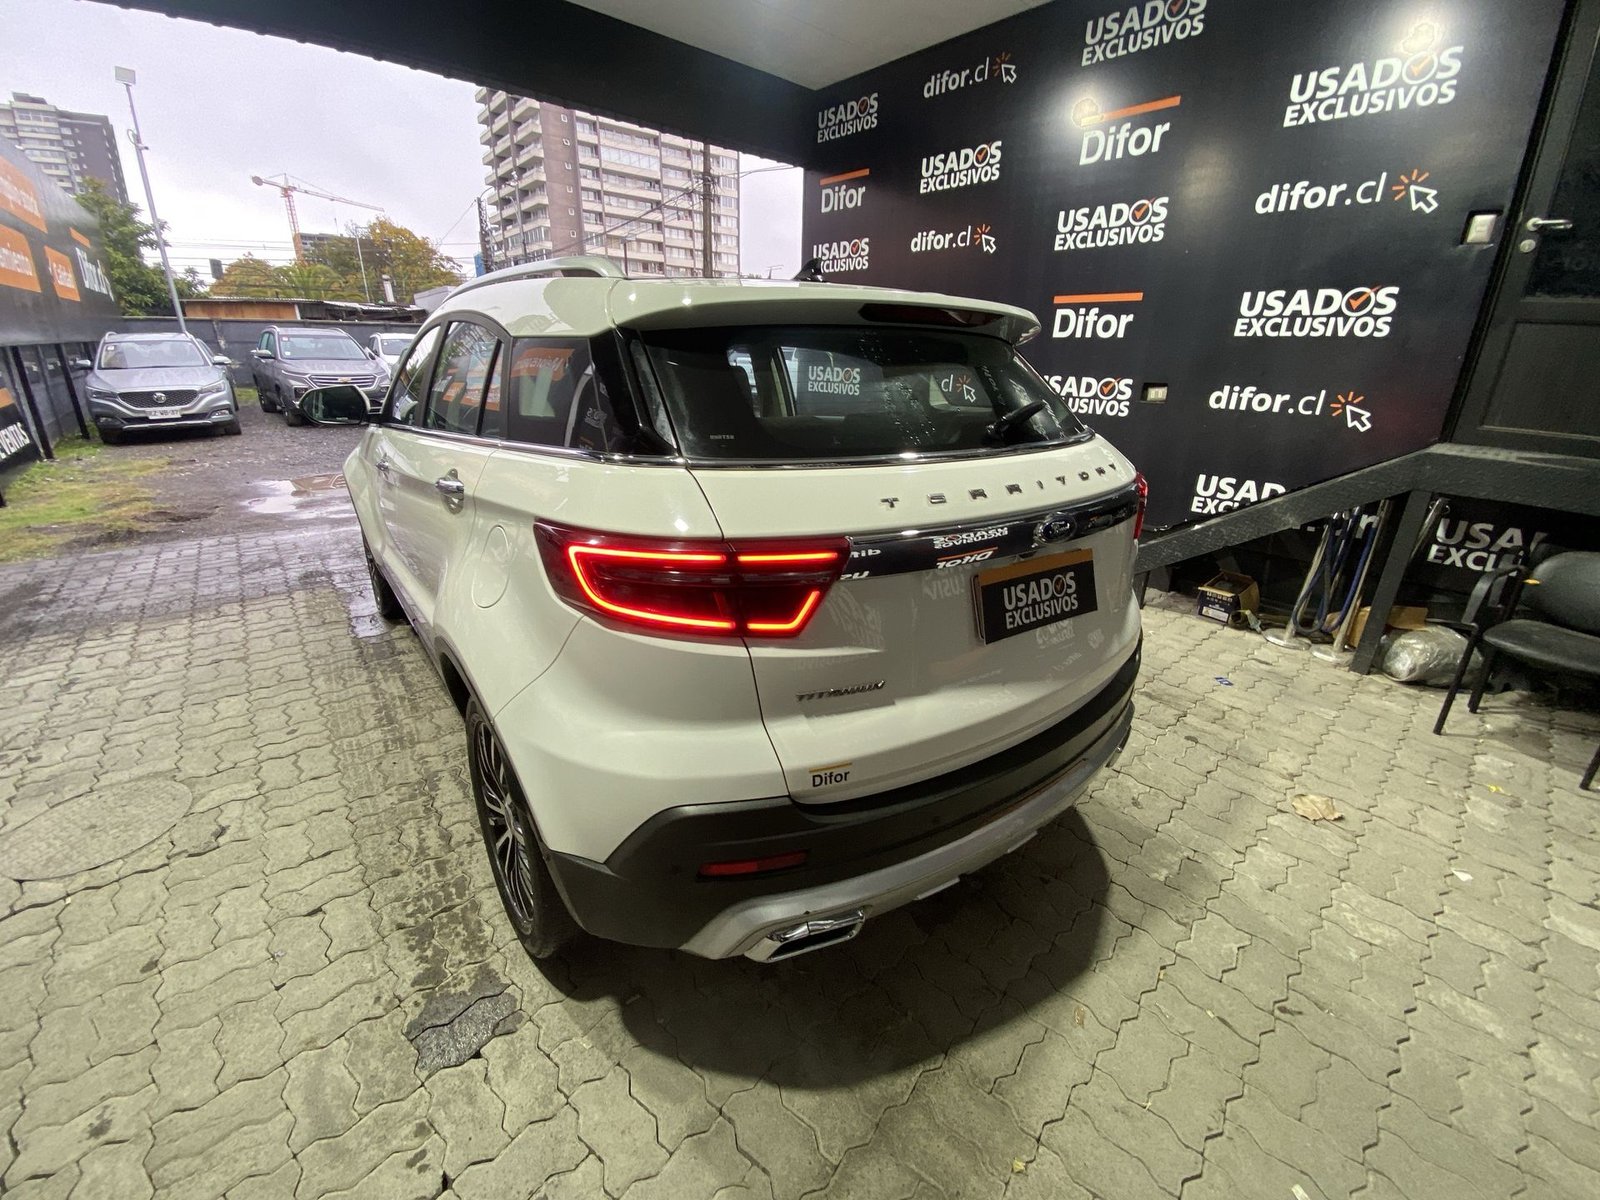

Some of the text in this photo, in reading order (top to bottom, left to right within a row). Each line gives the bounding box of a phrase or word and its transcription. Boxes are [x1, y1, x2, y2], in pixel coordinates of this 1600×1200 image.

[1085, 0, 1207, 45] USADOS
[1081, 13, 1205, 67] EXCLUSIVOS
[923, 57, 990, 99] difor.cl
[1289, 46, 1464, 103] USADOS
[818, 93, 878, 129] USADOS
[1283, 80, 1457, 127] EXCLUSIVOS
[817, 117, 878, 143] EXCLUSIVOS
[1079, 122, 1170, 166] Difor
[921, 140, 1002, 178] USADOS
[920, 165, 1000, 194] EXCLUSIVOS
[1255, 171, 1387, 215] difor.cl
[821, 184, 866, 214] Difor
[1057, 196, 1169, 233] USADOS
[813, 237, 870, 260] USADOS
[910, 225, 971, 252] difor.cl
[1054, 223, 1165, 251] EXCLUSIVOS
[820, 256, 869, 273] CLUSIVOS
[1240, 286, 1400, 318] USADOS
[1052, 307, 1135, 339] Difor
[1234, 315, 1392, 338] EXCLUSIVOS
[808, 365, 861, 385] USADOS
[808, 380, 860, 396] EXCLUSIVOS
[1043, 375, 1133, 400] SADOS
[1063, 397, 1130, 417] USIVOS
[1209, 385, 1326, 416] difor.cl
[1196, 473, 1287, 503] USAD
[1003, 571, 1077, 611] USADOS
[1005, 594, 1079, 630] EXCLUSIVOS
[812, 770, 850, 788] Difor
